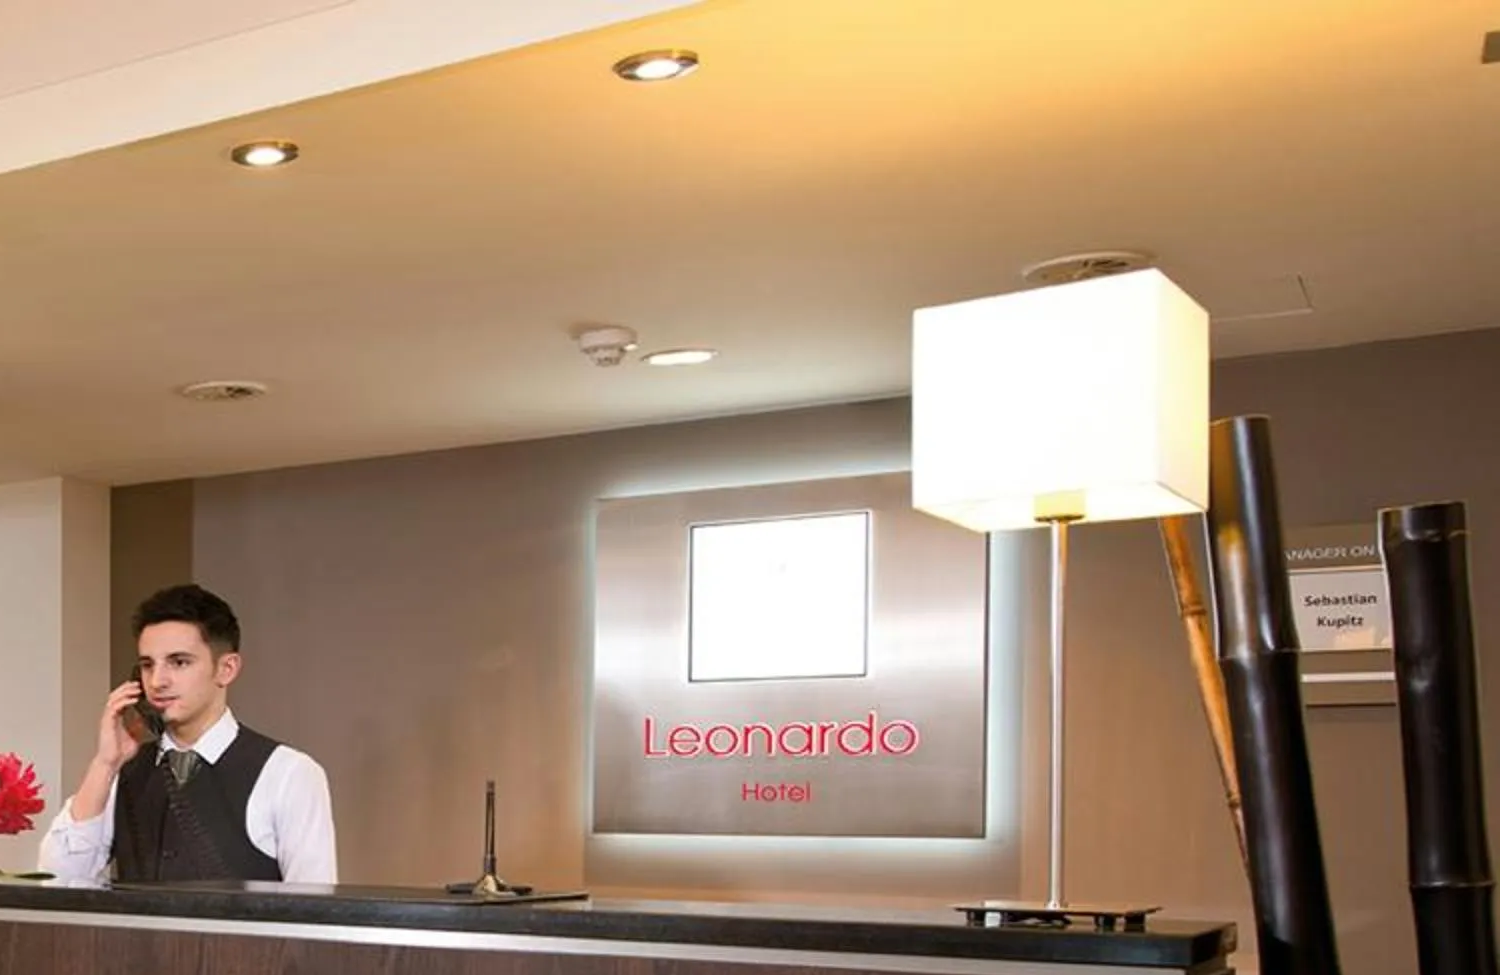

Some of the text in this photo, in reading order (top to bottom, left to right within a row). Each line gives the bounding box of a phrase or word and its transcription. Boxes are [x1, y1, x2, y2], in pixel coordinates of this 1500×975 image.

[1349, 544, 1376, 558] ON
[1303, 594, 1378, 607] Sebastian
[1316, 615, 1364, 629] Kupitz
[643, 711, 918, 758] Leonardo
[741, 781, 812, 803] Hotel
